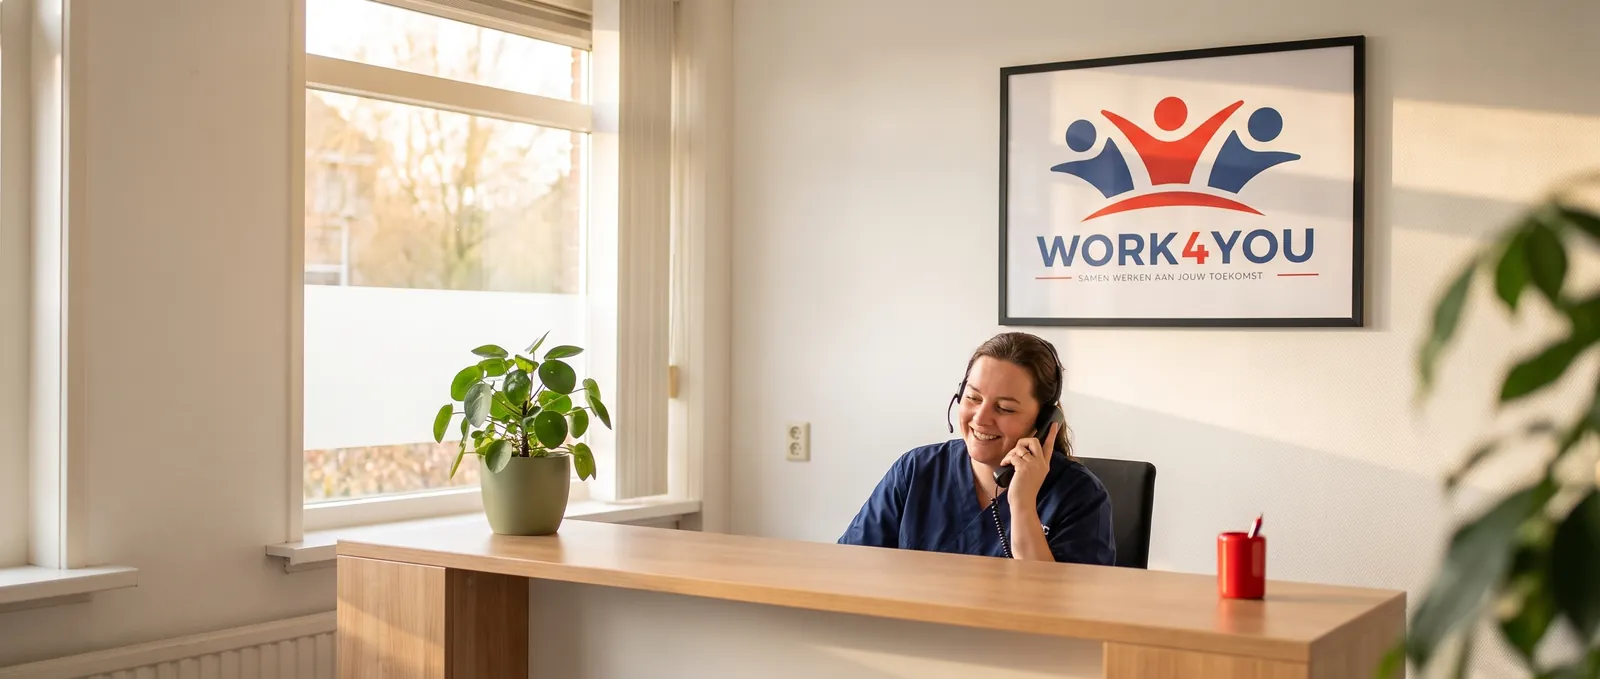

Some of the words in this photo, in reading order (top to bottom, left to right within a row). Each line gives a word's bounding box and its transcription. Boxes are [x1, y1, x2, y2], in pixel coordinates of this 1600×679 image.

[1036, 228, 1314, 267] WORK4YOU
[1078, 274, 1110, 282] SAMEN
[1112, 273, 1151, 282] WERKEN
[1154, 273, 1175, 281] AAN
[1177, 273, 1206, 281] JOUW
[1209, 272, 1263, 281] TOEKOMST
